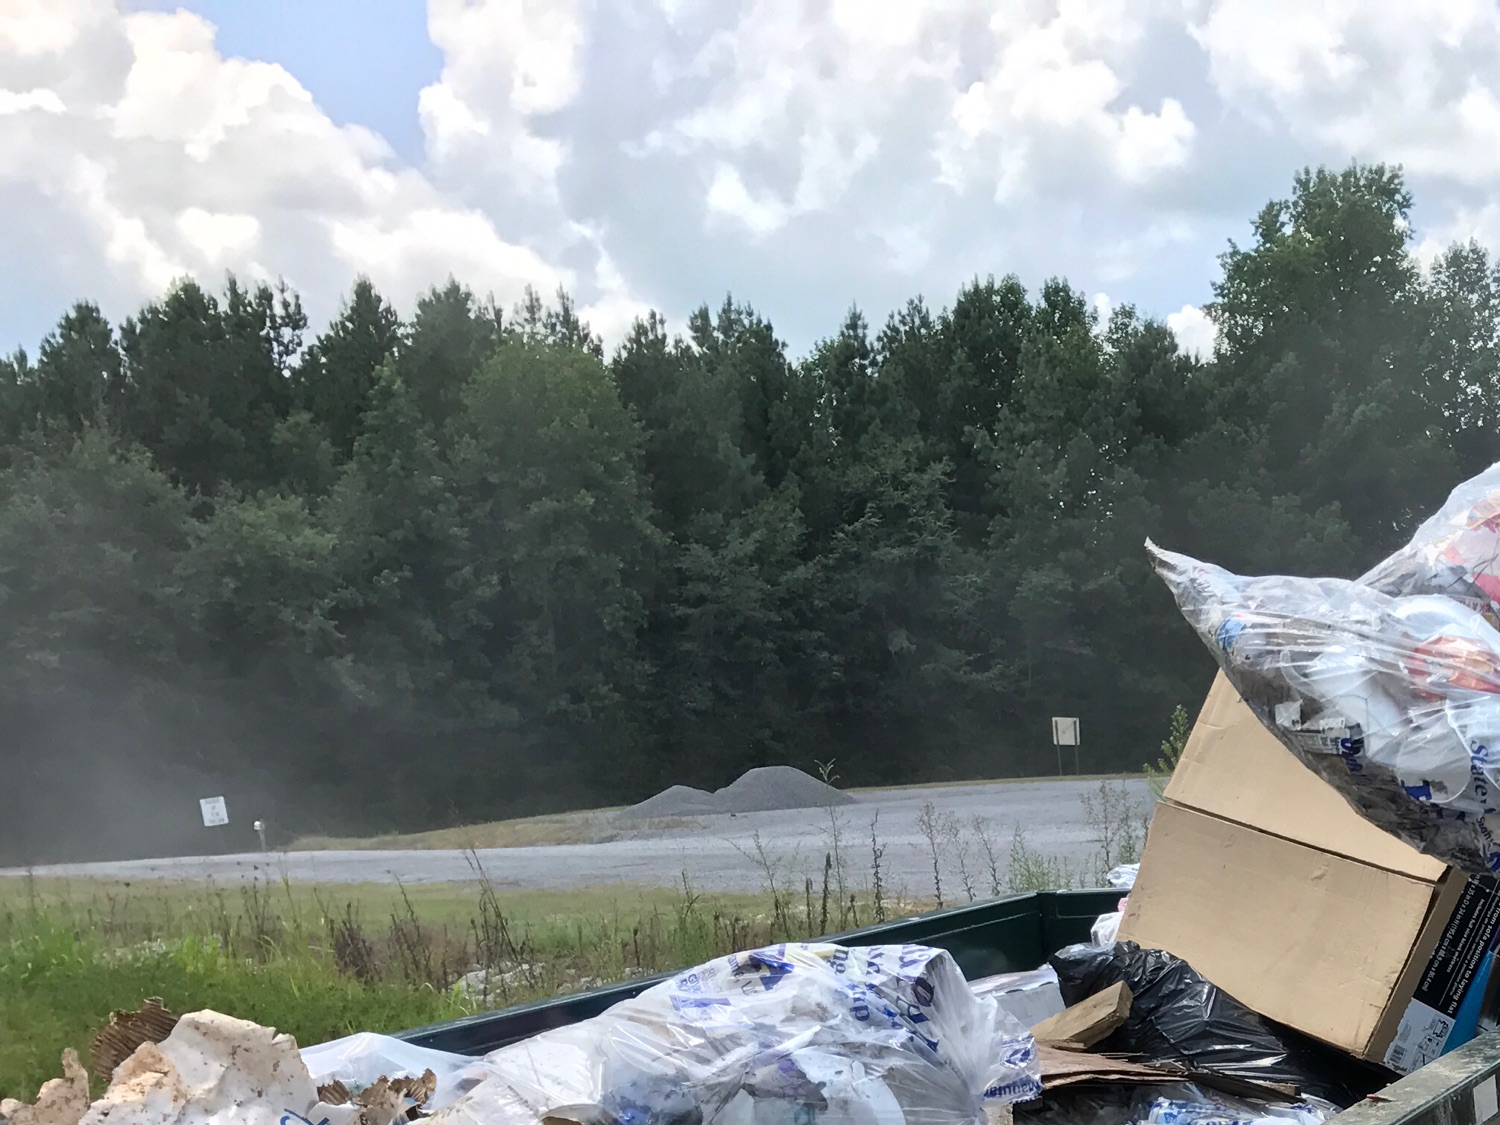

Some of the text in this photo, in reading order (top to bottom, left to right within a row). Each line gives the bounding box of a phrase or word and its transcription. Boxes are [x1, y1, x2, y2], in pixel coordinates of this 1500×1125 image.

[1483, 925, 1493, 941] sofa
[1469, 940, 1485, 970] position
[1465, 970, 1472, 978] to
[1453, 979, 1469, 1001] laying
[1447, 1001, 1458, 1014] flat
